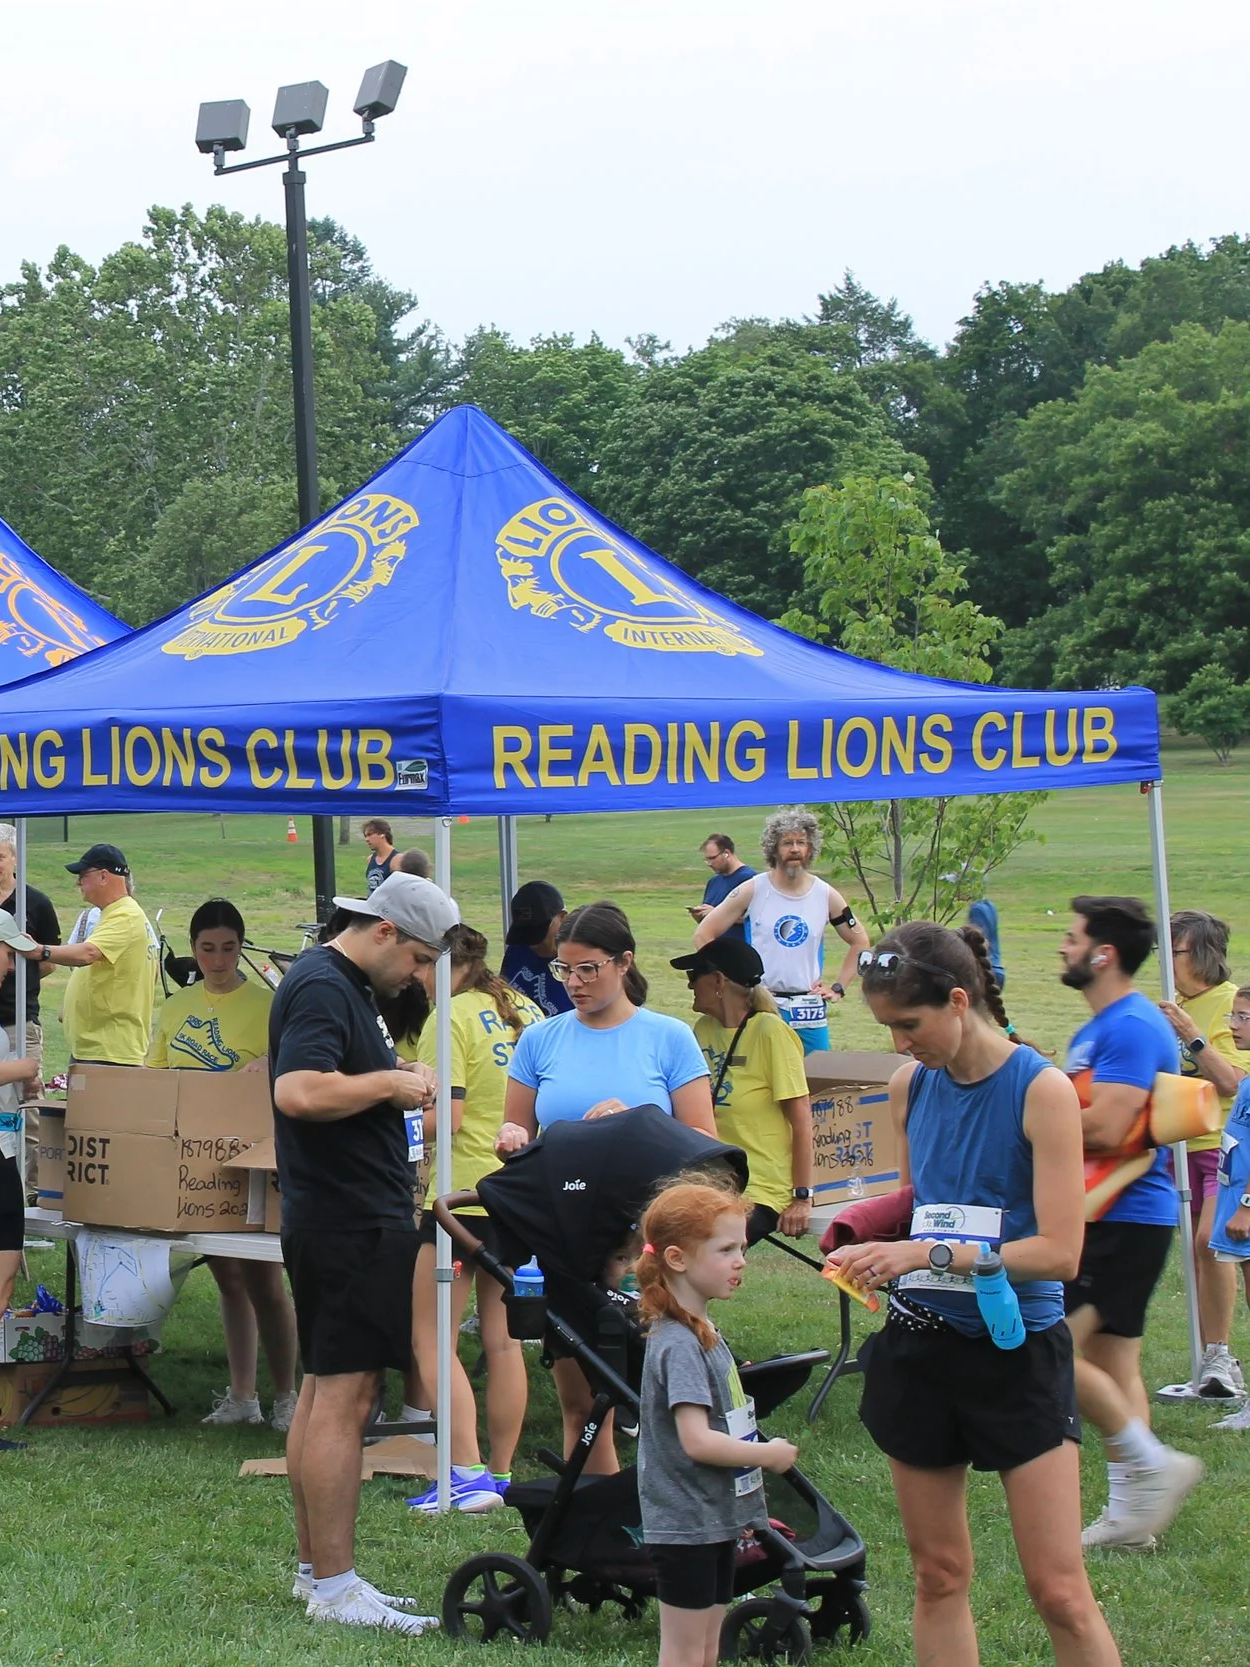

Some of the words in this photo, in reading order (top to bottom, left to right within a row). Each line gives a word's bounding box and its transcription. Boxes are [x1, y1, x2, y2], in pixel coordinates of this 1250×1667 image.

[336, 499, 412, 540] ONS
[504, 502, 578, 551] LIO
[81, 725, 232, 788] LIONS
[247, 728, 397, 790] CLUB
[493, 720, 767, 789] READING
[787, 713, 954, 779] LIONS
[971, 707, 1119, 771] CLUB
[478, 1009, 541, 1034] RCE
[796, 1006, 825, 1020] 3175
[186, 1036, 203, 1052] ROAD
[201, 1048, 219, 1063] RACE
[212, 1017, 224, 1047] READING
[221, 1044, 241, 1063] LIONS
[68, 1135, 110, 1160] DIST
[67, 1161, 110, 1185] RICT
[178, 1164, 241, 1198] Reading
[562, 1179, 587, 1191] Joie
[177, 1196, 215, 1219] Lions
[219, 1200, 249, 1217] 202
[924, 1210, 951, 1219] Second
[933, 1218, 956, 1228] Wind
[606, 1289, 631, 1306] Joie
[581, 1422, 598, 1447] Joie
